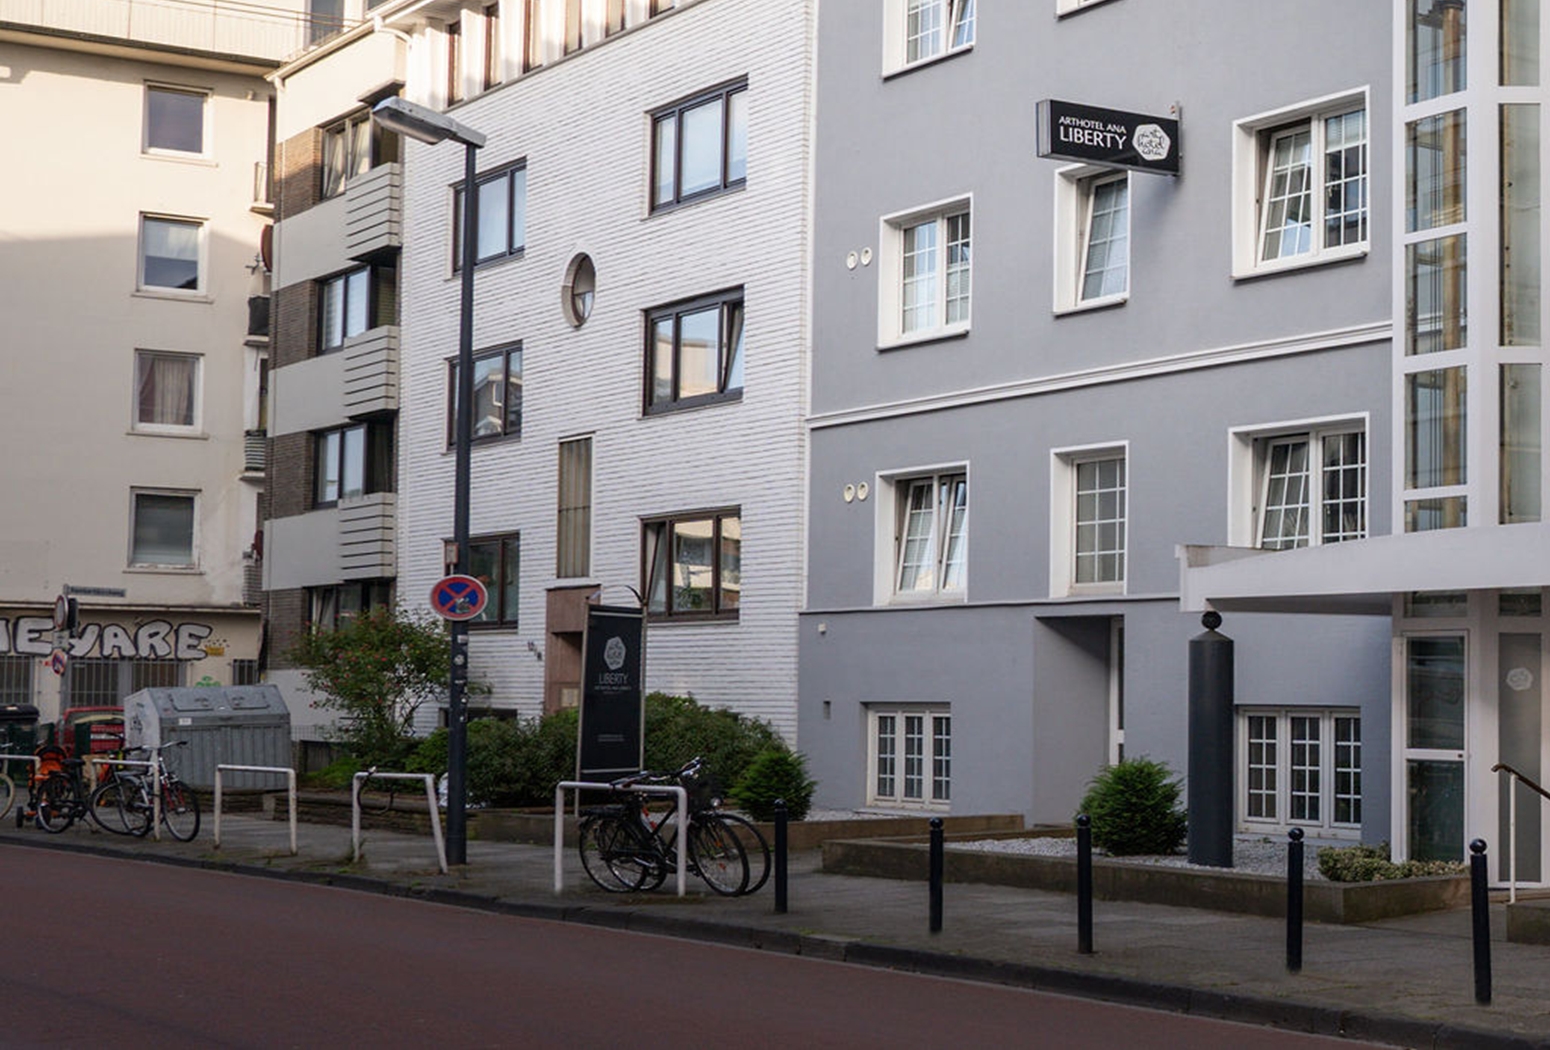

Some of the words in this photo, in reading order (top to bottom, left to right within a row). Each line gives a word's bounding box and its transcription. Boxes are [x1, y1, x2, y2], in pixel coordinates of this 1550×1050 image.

[1058, 116, 1105, 131] ARTHOTEL
[1106, 124, 1127, 134] ANA
[1060, 126, 1127, 150] LIBERTY
[599, 672, 629, 685] LIBERTY
